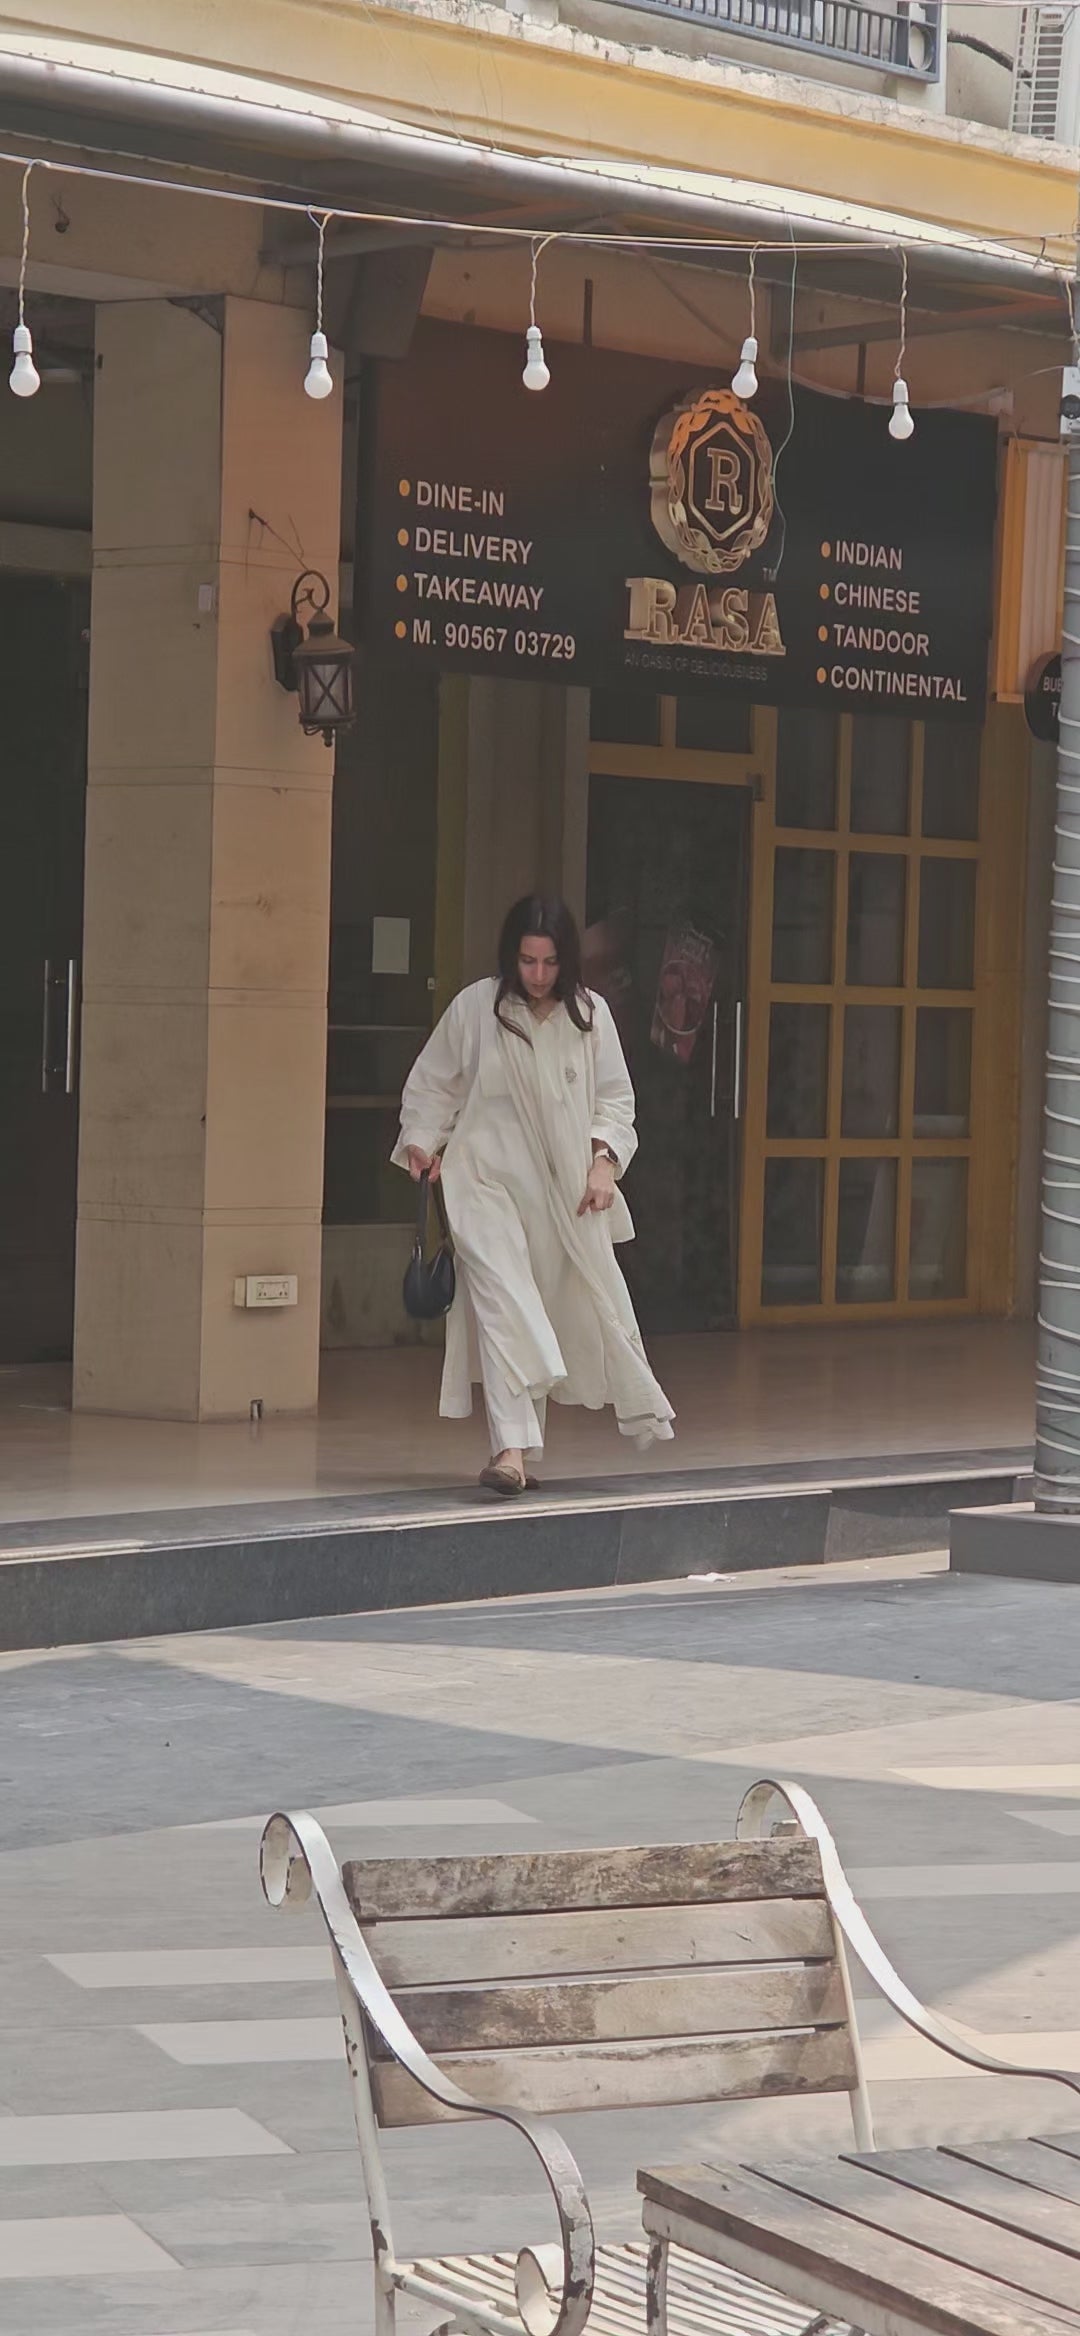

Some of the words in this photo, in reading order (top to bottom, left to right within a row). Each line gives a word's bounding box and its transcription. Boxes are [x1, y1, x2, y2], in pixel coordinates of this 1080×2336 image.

[416, 480, 504, 516] DINE-IN
[705, 447, 743, 515] R
[415, 527, 533, 565] DELIVERY
[836, 540, 903, 570] INDIAN
[414, 572, 544, 611] TAKEAWAY
[834, 582, 920, 614] CHINESE
[624, 576, 787, 656] RASA
[413, 618, 437, 645] M.
[445, 622, 508, 652] 90567
[514, 629, 576, 660] 03729
[833, 623, 929, 656] TANDOOR
[831, 665, 967, 701] CONTINENTAL
